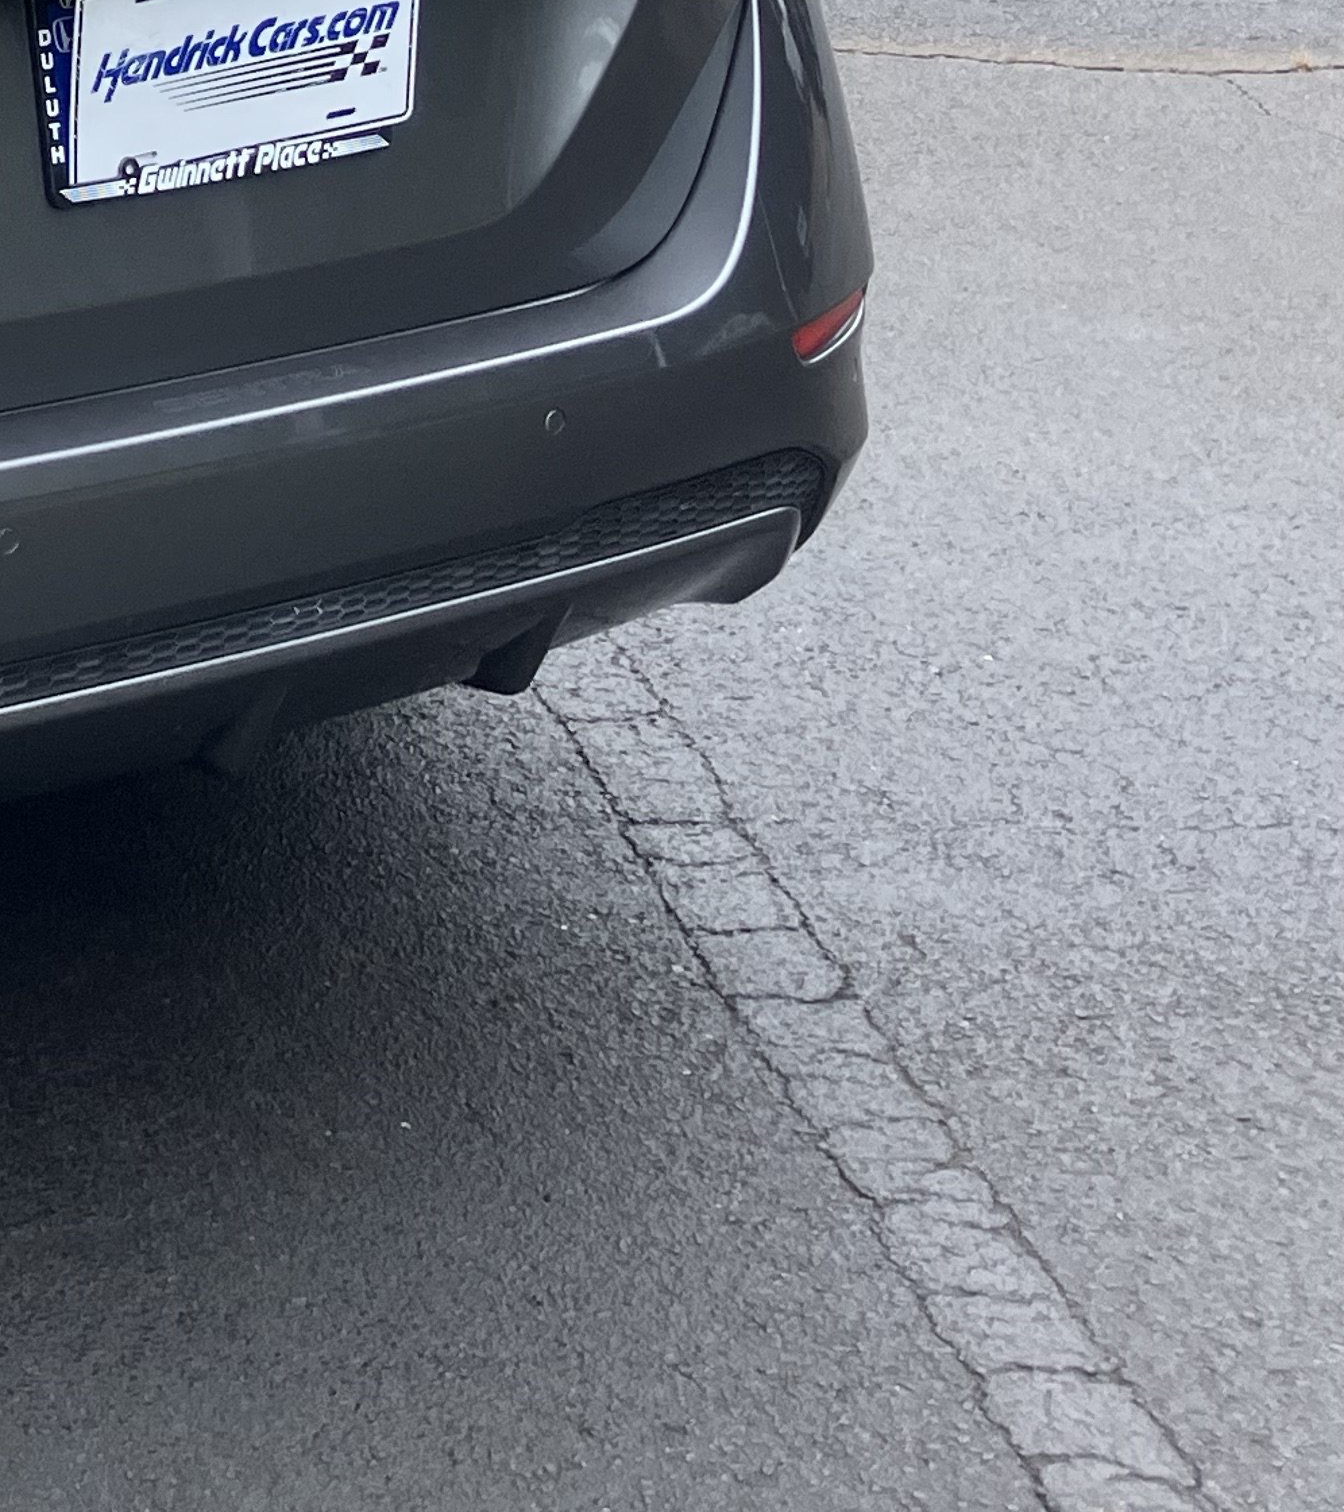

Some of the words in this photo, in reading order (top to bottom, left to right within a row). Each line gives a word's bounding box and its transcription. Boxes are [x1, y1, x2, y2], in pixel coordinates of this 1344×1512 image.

[37, 28, 67, 165] DULUTH
[137, 147, 251, 194] Gwinnett
[253, 139, 324, 175] Place
